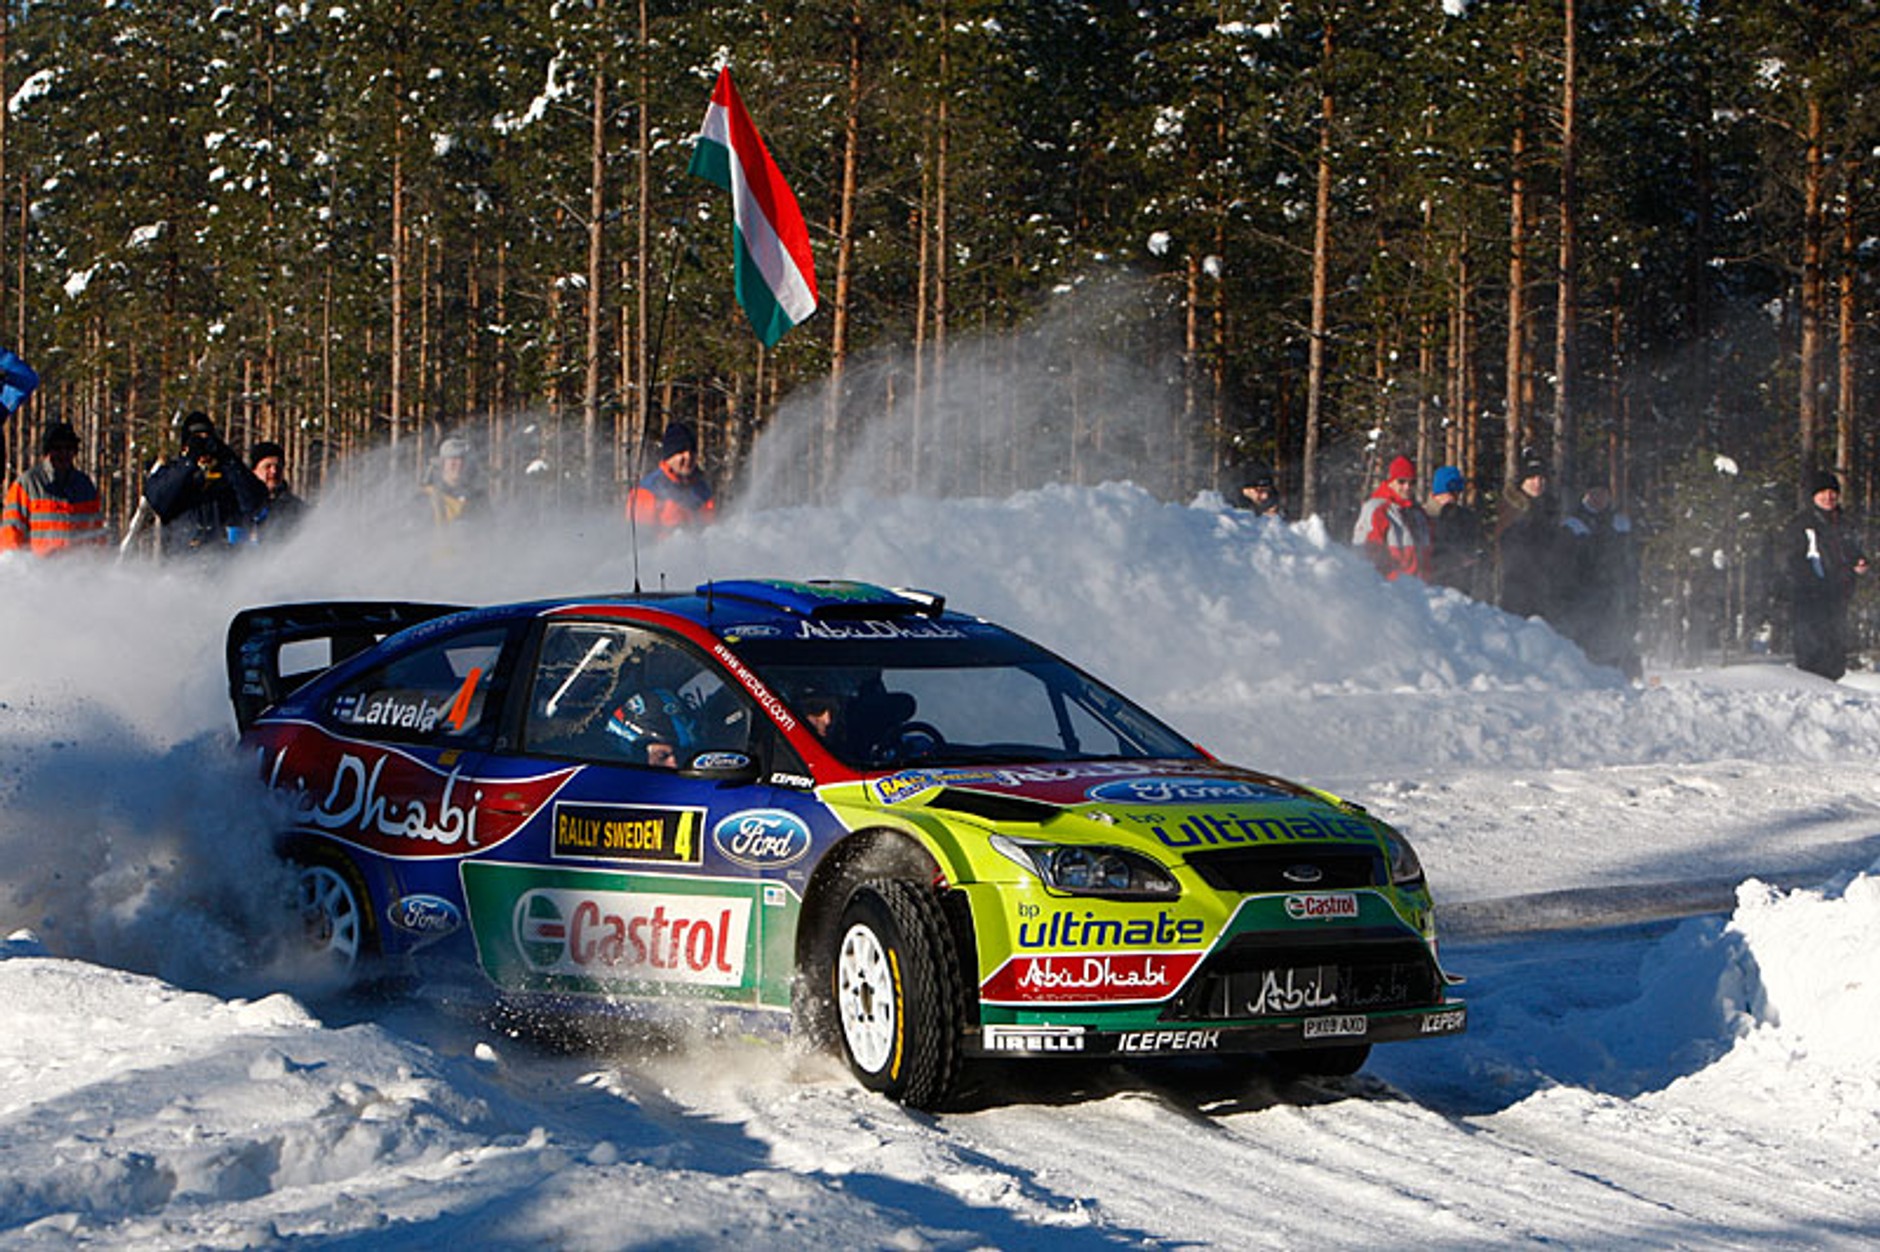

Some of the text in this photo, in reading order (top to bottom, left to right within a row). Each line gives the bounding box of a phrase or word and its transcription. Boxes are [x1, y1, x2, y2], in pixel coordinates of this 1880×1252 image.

[352, 693, 437, 733] Latvala
[318, 753, 480, 846] Dhabi
[1129, 781, 1263, 801] Ford
[559, 811, 695, 861] RALLY SWEDEN 4
[731, 817, 796, 857] Ford
[1152, 811, 1376, 847] ultimate
[404, 901, 448, 927] Ford
[1019, 902, 1040, 922] bp
[1305, 896, 1355, 915] Castrol
[569, 900, 733, 974] Castrol
[1019, 911, 1205, 948] ultimate
[1018, 956, 1169, 988] Abu Dhabi
[984, 1023, 1085, 1050] PIRELLI
[1118, 1031, 1219, 1051] ICEPEAK
